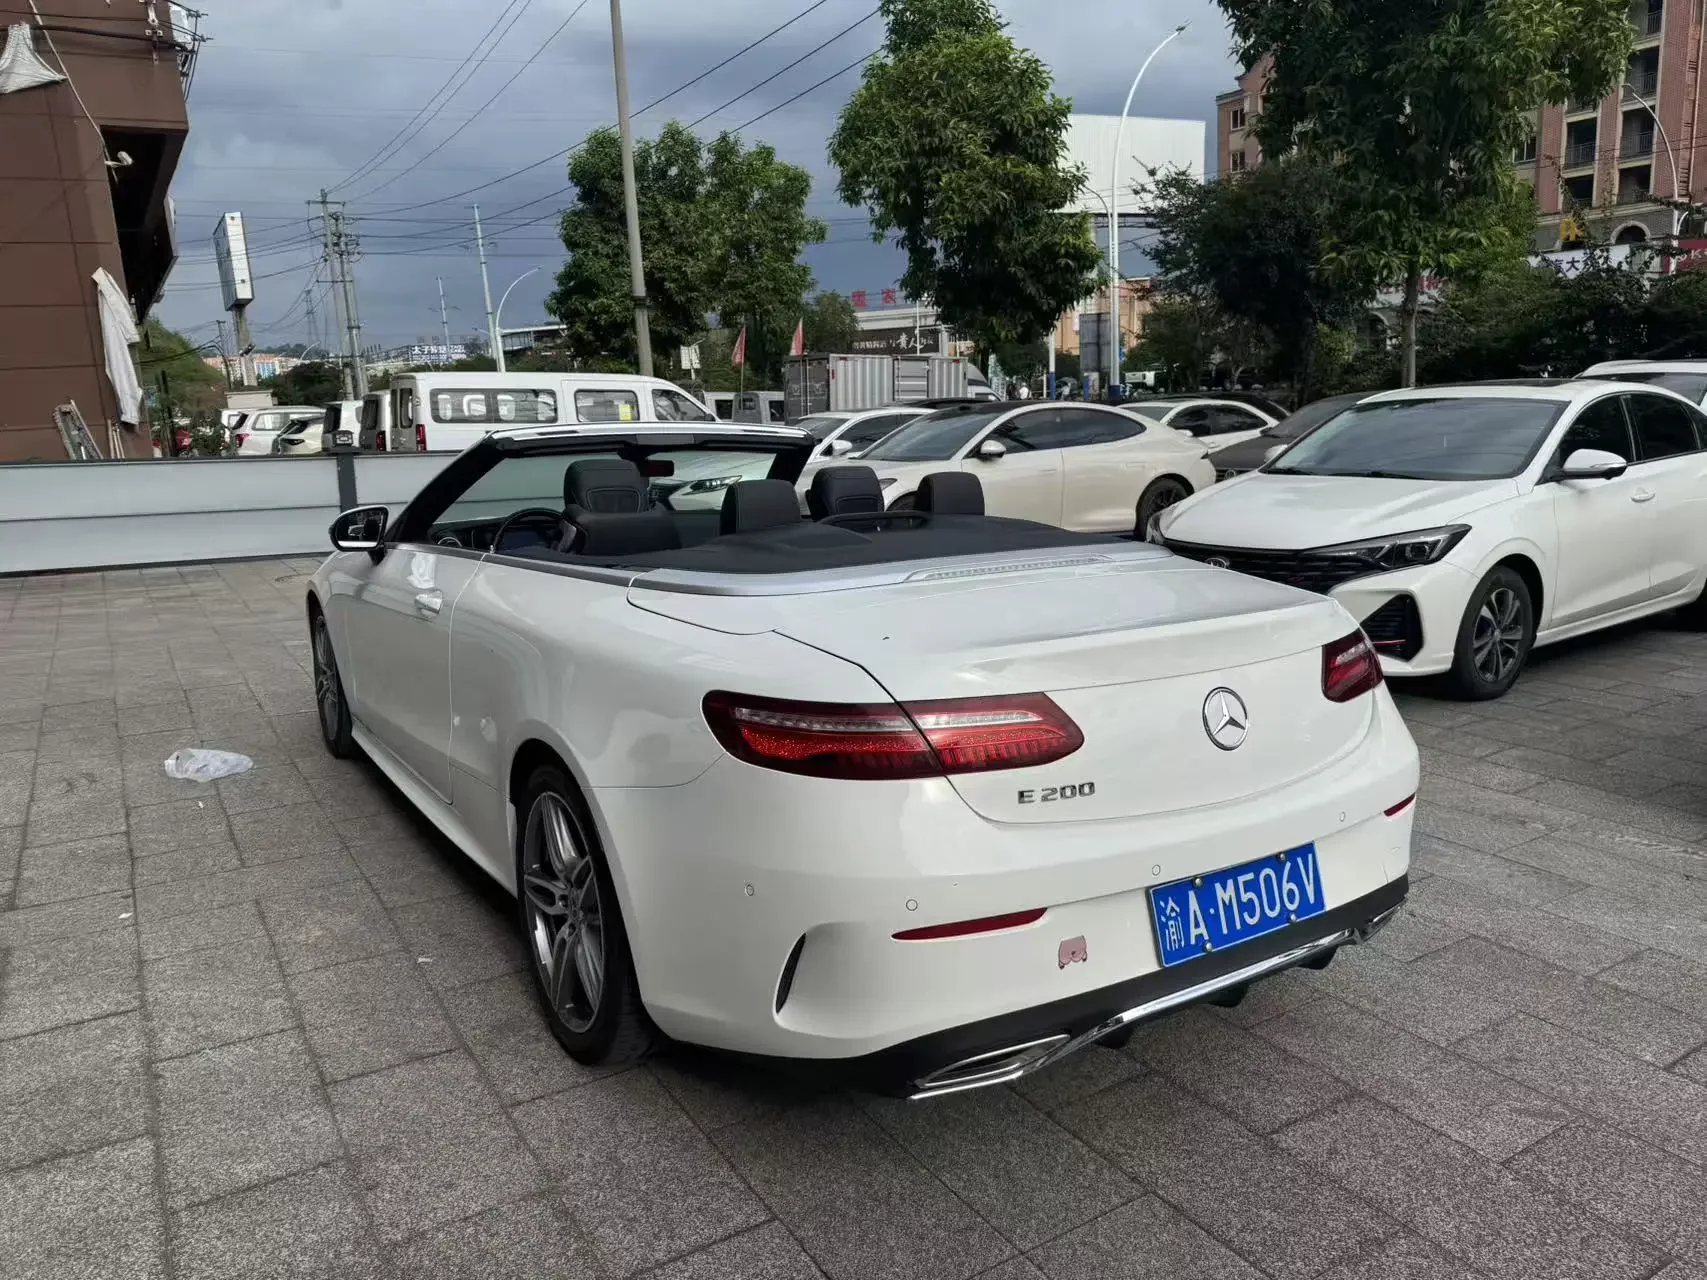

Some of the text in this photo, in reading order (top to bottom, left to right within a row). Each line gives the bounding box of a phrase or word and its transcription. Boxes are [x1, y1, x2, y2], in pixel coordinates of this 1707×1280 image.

[1018, 782, 1095, 804] E 200
[1159, 852, 1314, 951] 渝A·M506V
